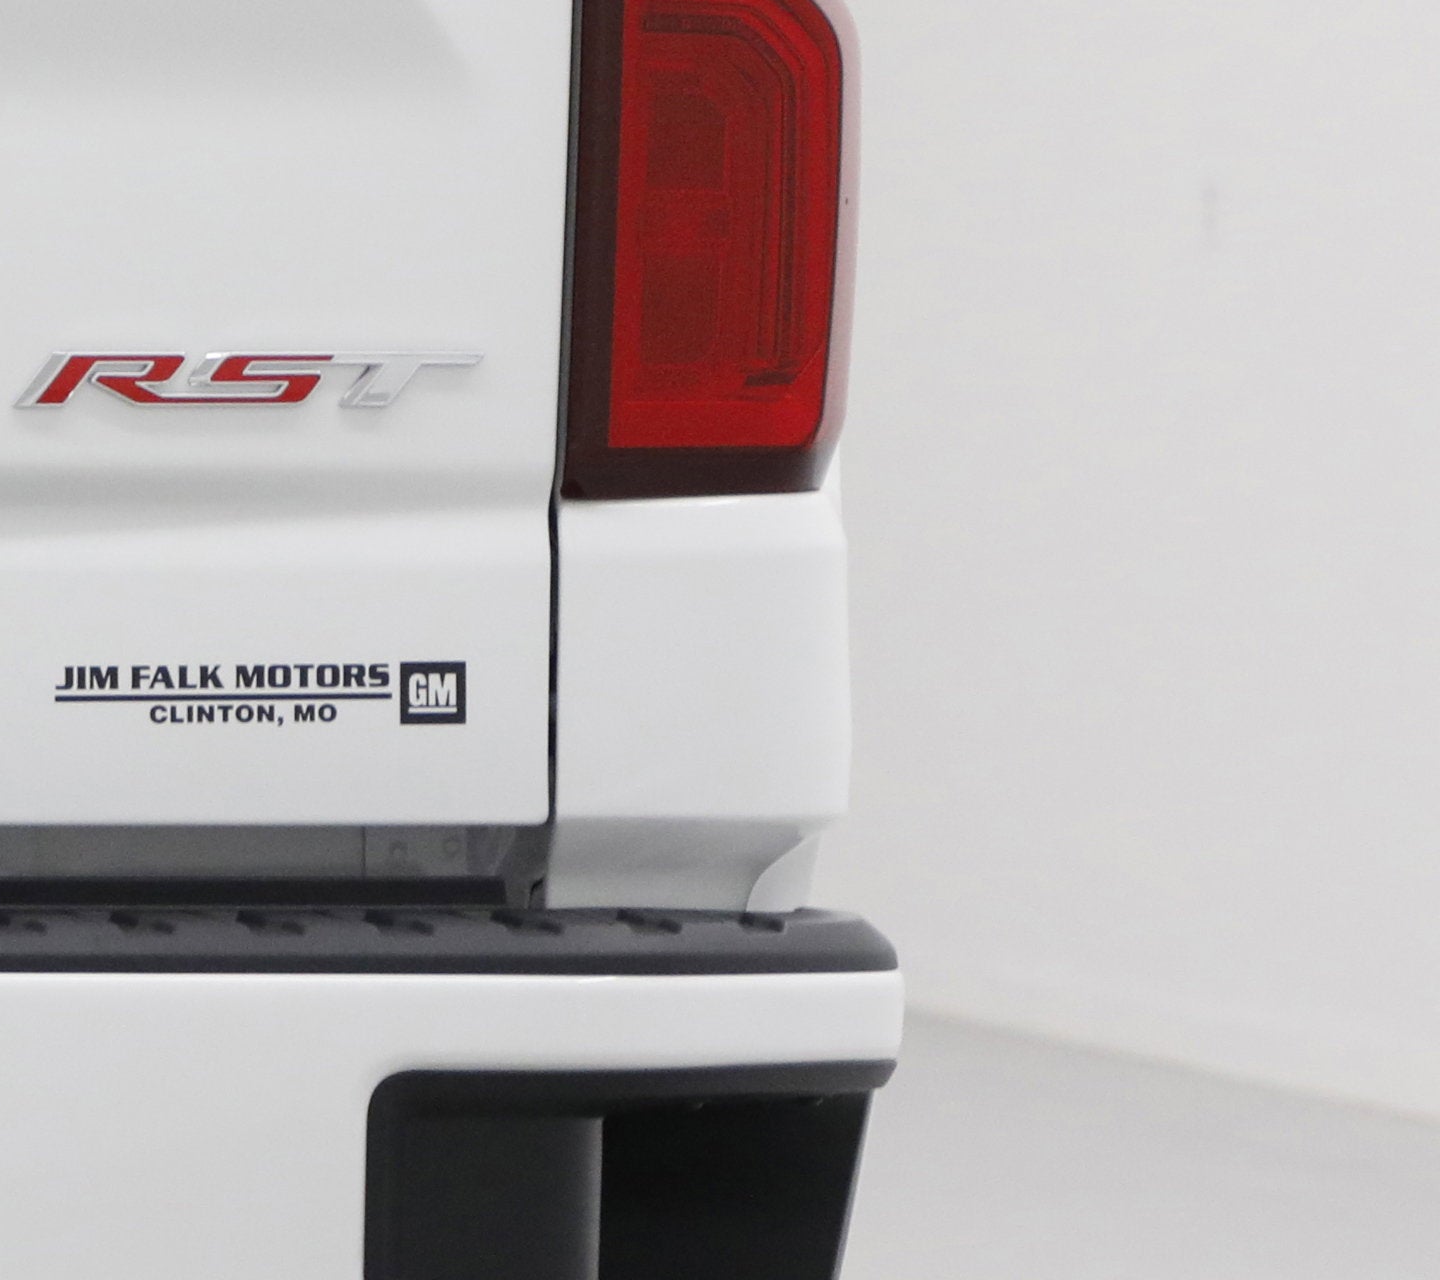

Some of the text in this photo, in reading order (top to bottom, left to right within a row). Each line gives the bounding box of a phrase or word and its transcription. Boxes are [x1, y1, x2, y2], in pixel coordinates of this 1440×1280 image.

[12, 350, 485, 409] RST
[55, 662, 391, 690] JIM FALK MOTORS
[408, 672, 458, 707] GM
[149, 703, 337, 727] CLINTON, MO
